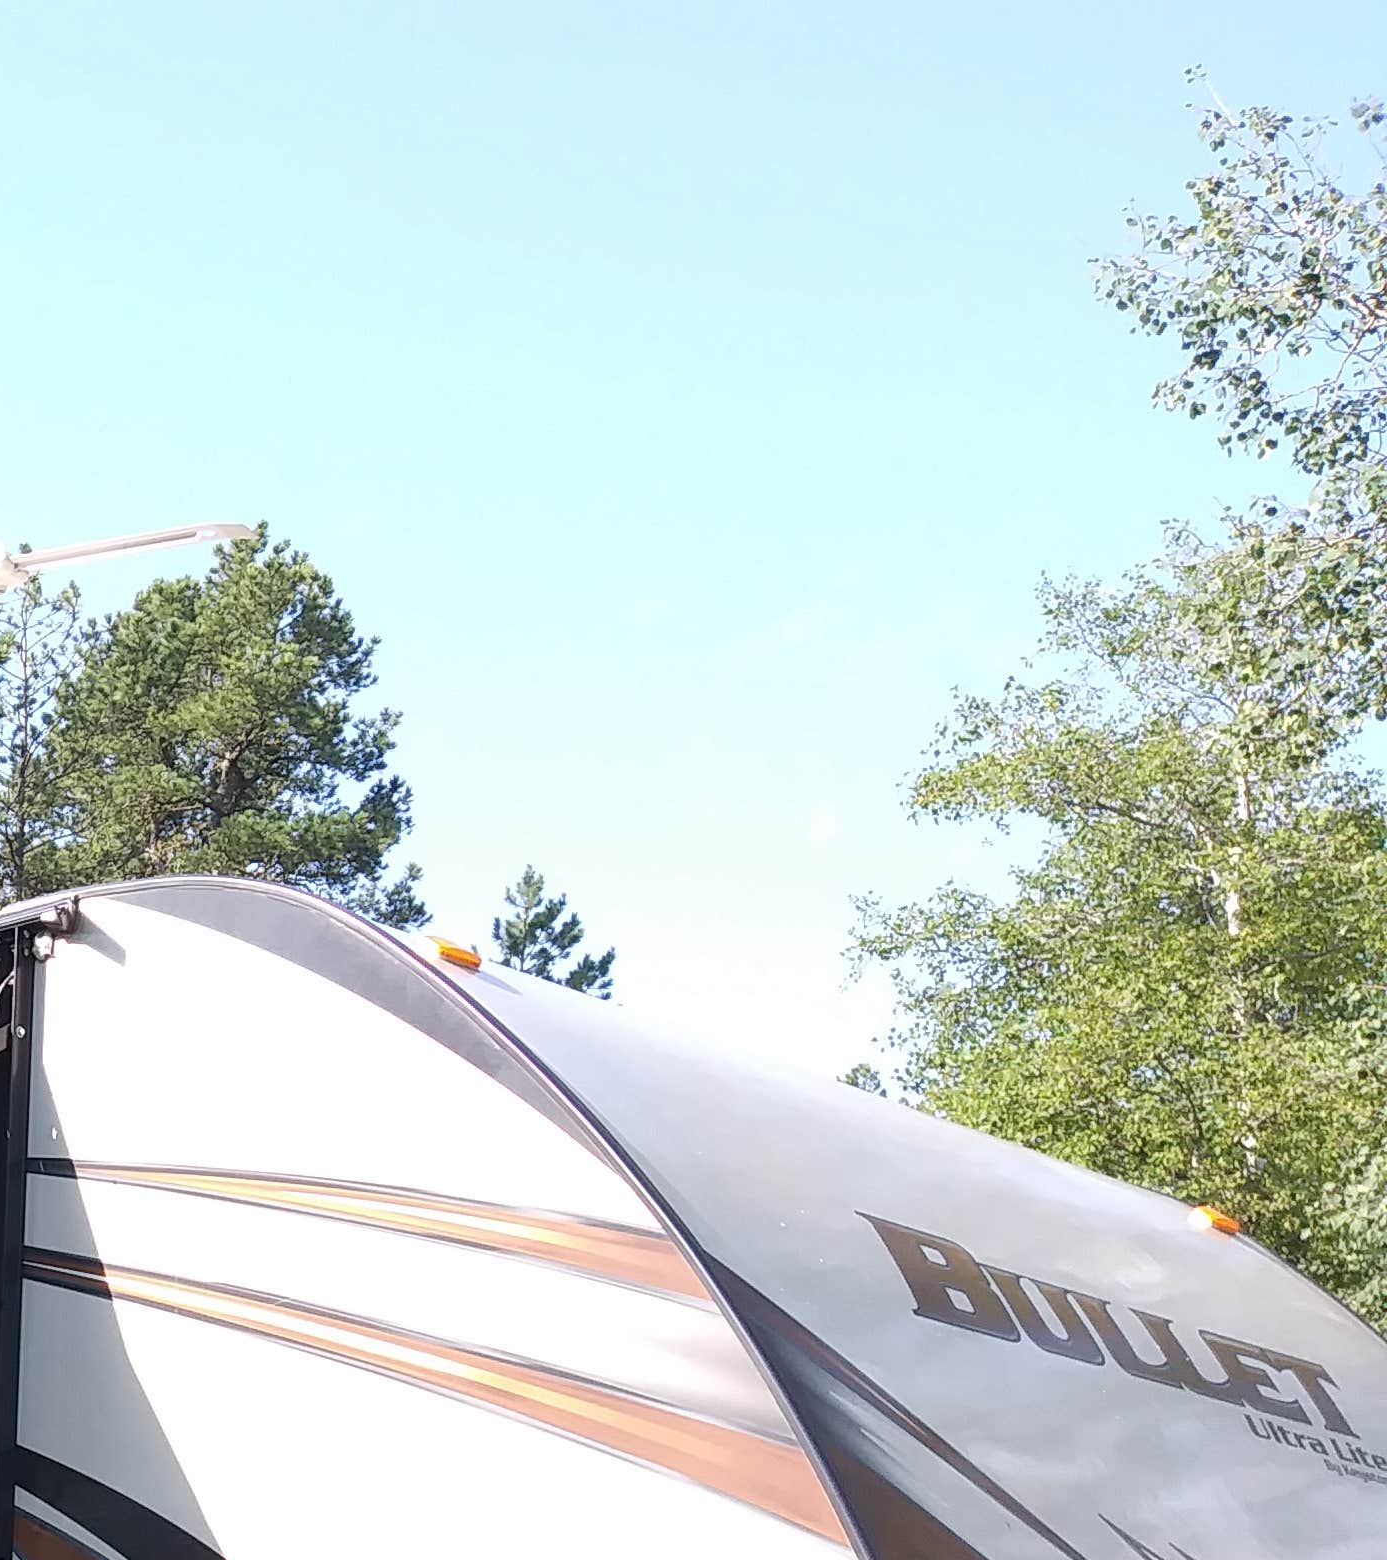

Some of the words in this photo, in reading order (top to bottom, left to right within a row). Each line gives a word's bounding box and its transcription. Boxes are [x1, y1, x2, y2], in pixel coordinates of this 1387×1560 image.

[854, 1210, 1359, 1439] BULLET
[1243, 1413, 1329, 1456] Ultra
[1328, 1438, 1387, 1472] Lite
